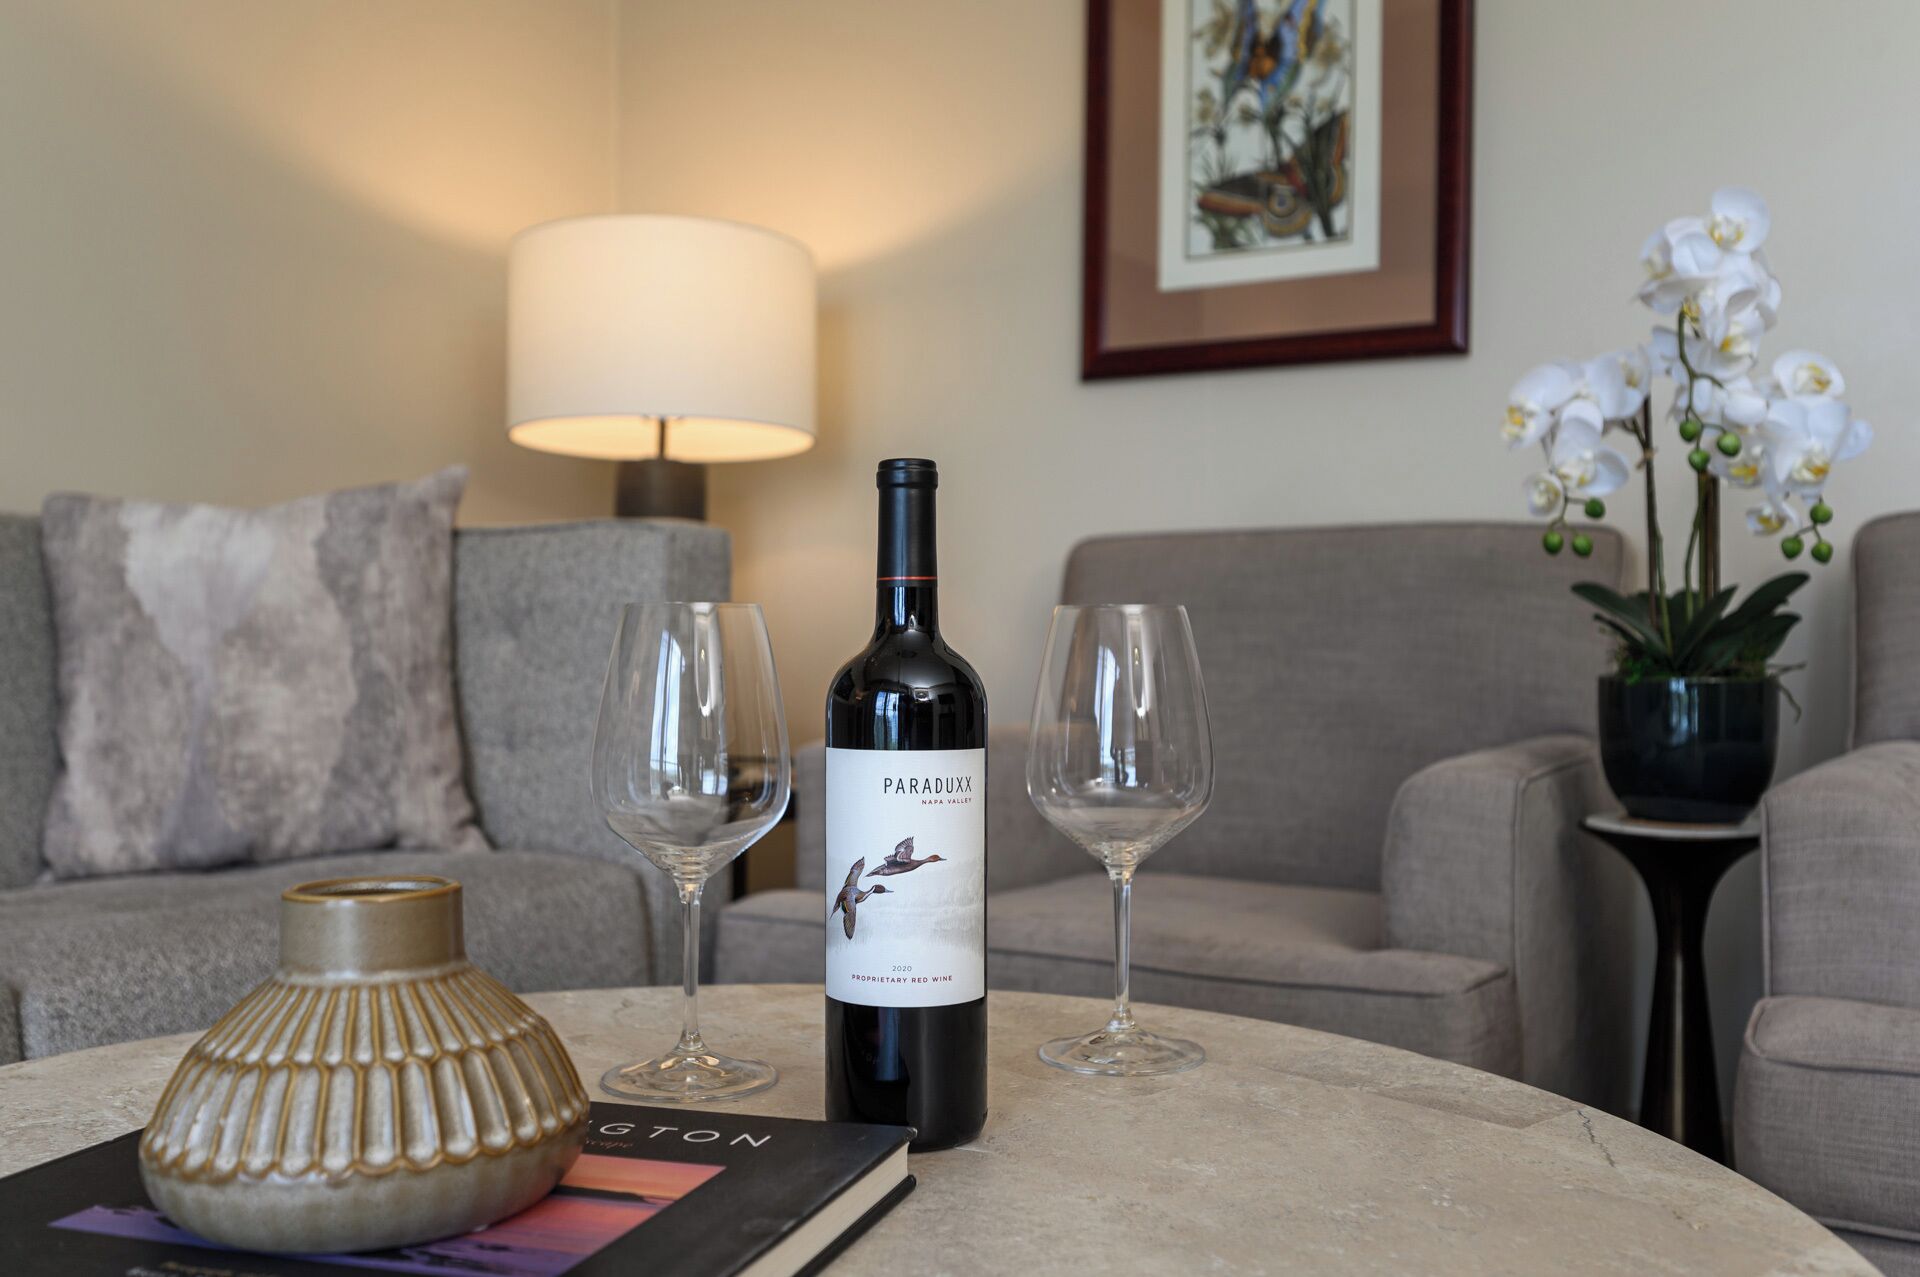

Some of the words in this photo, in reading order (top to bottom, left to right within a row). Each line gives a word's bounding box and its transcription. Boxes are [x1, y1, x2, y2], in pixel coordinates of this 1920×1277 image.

[883, 776, 972, 794] PARADUXX
[851, 974, 907, 984] PROPRIETARY
[931, 975, 953, 983] WINE
[587, 1120, 771, 1148] GTON
